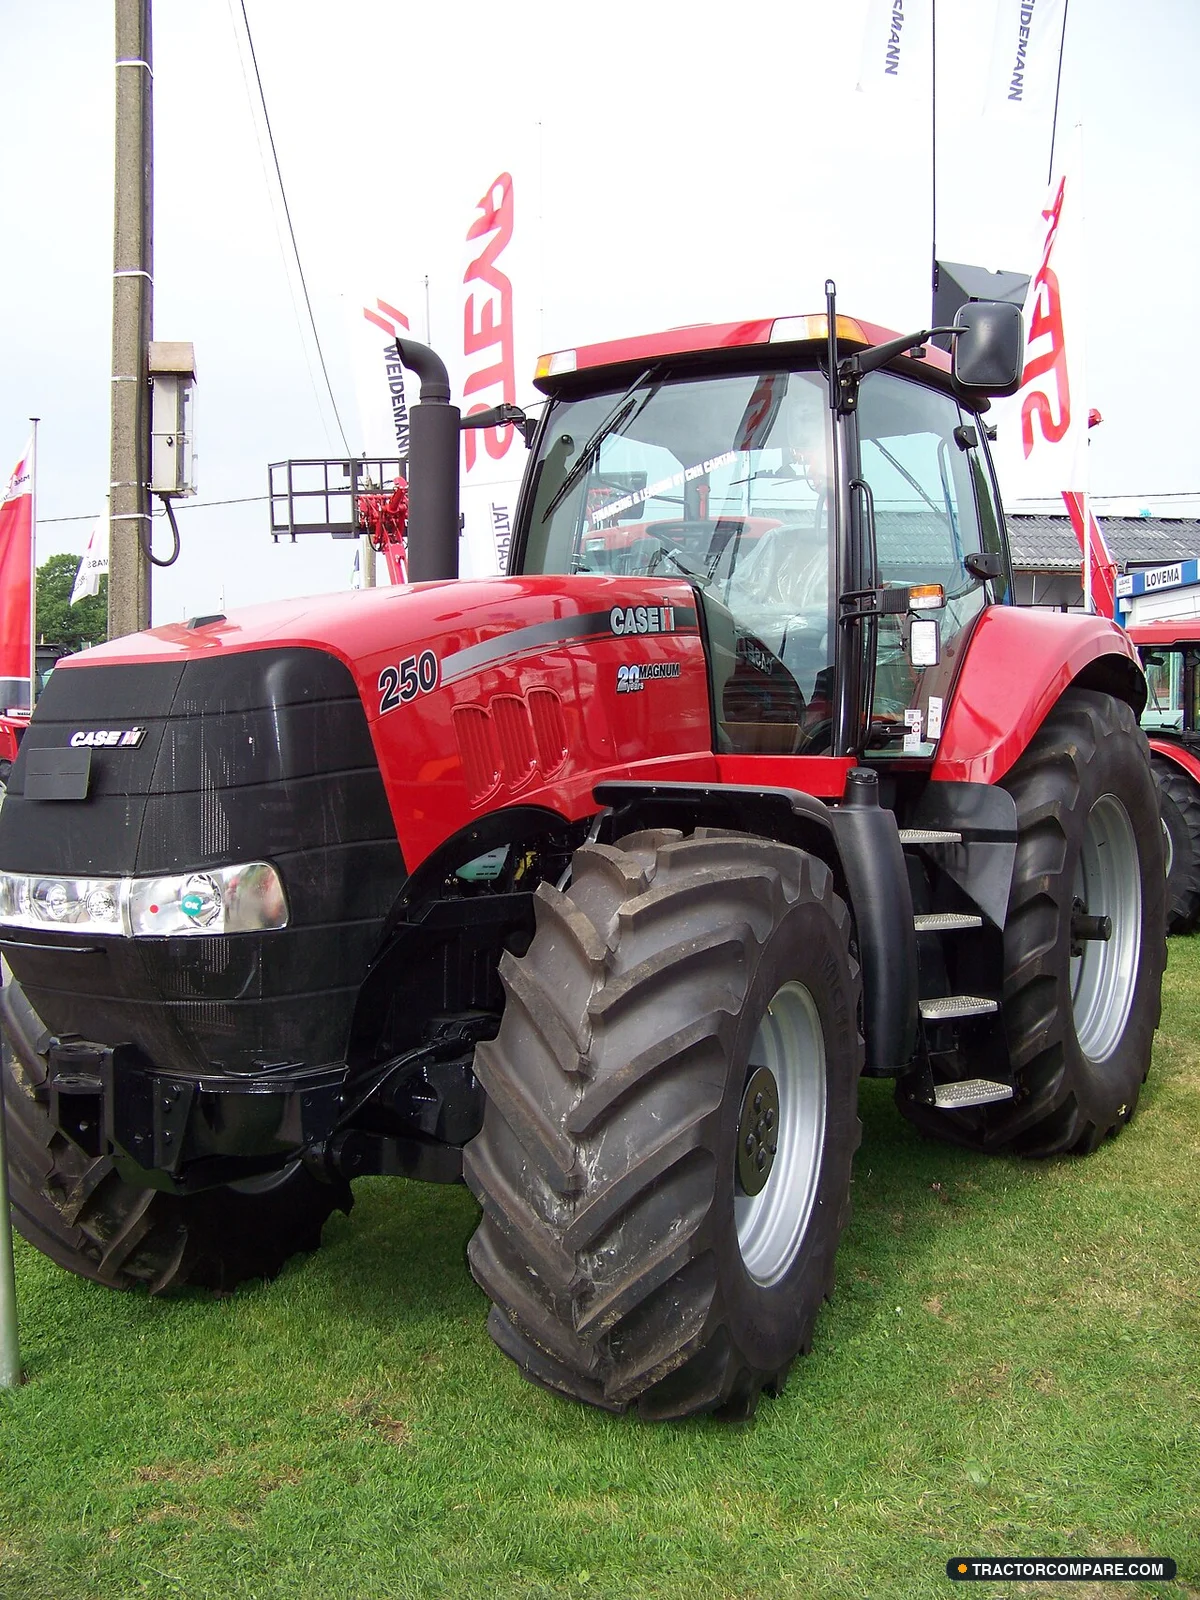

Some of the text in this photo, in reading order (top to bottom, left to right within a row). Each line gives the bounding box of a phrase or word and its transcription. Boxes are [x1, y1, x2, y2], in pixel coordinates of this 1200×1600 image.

[1146, 568, 1180, 588] LOVEMA
[610, 607, 659, 635] CASE
[378, 649, 438, 715] 250
[616, 663, 680, 692] 20 MAGNUM
[626, 681, 644, 693] years
[70, 731, 121, 747] CASE
[184, 901, 199, 911] OK
